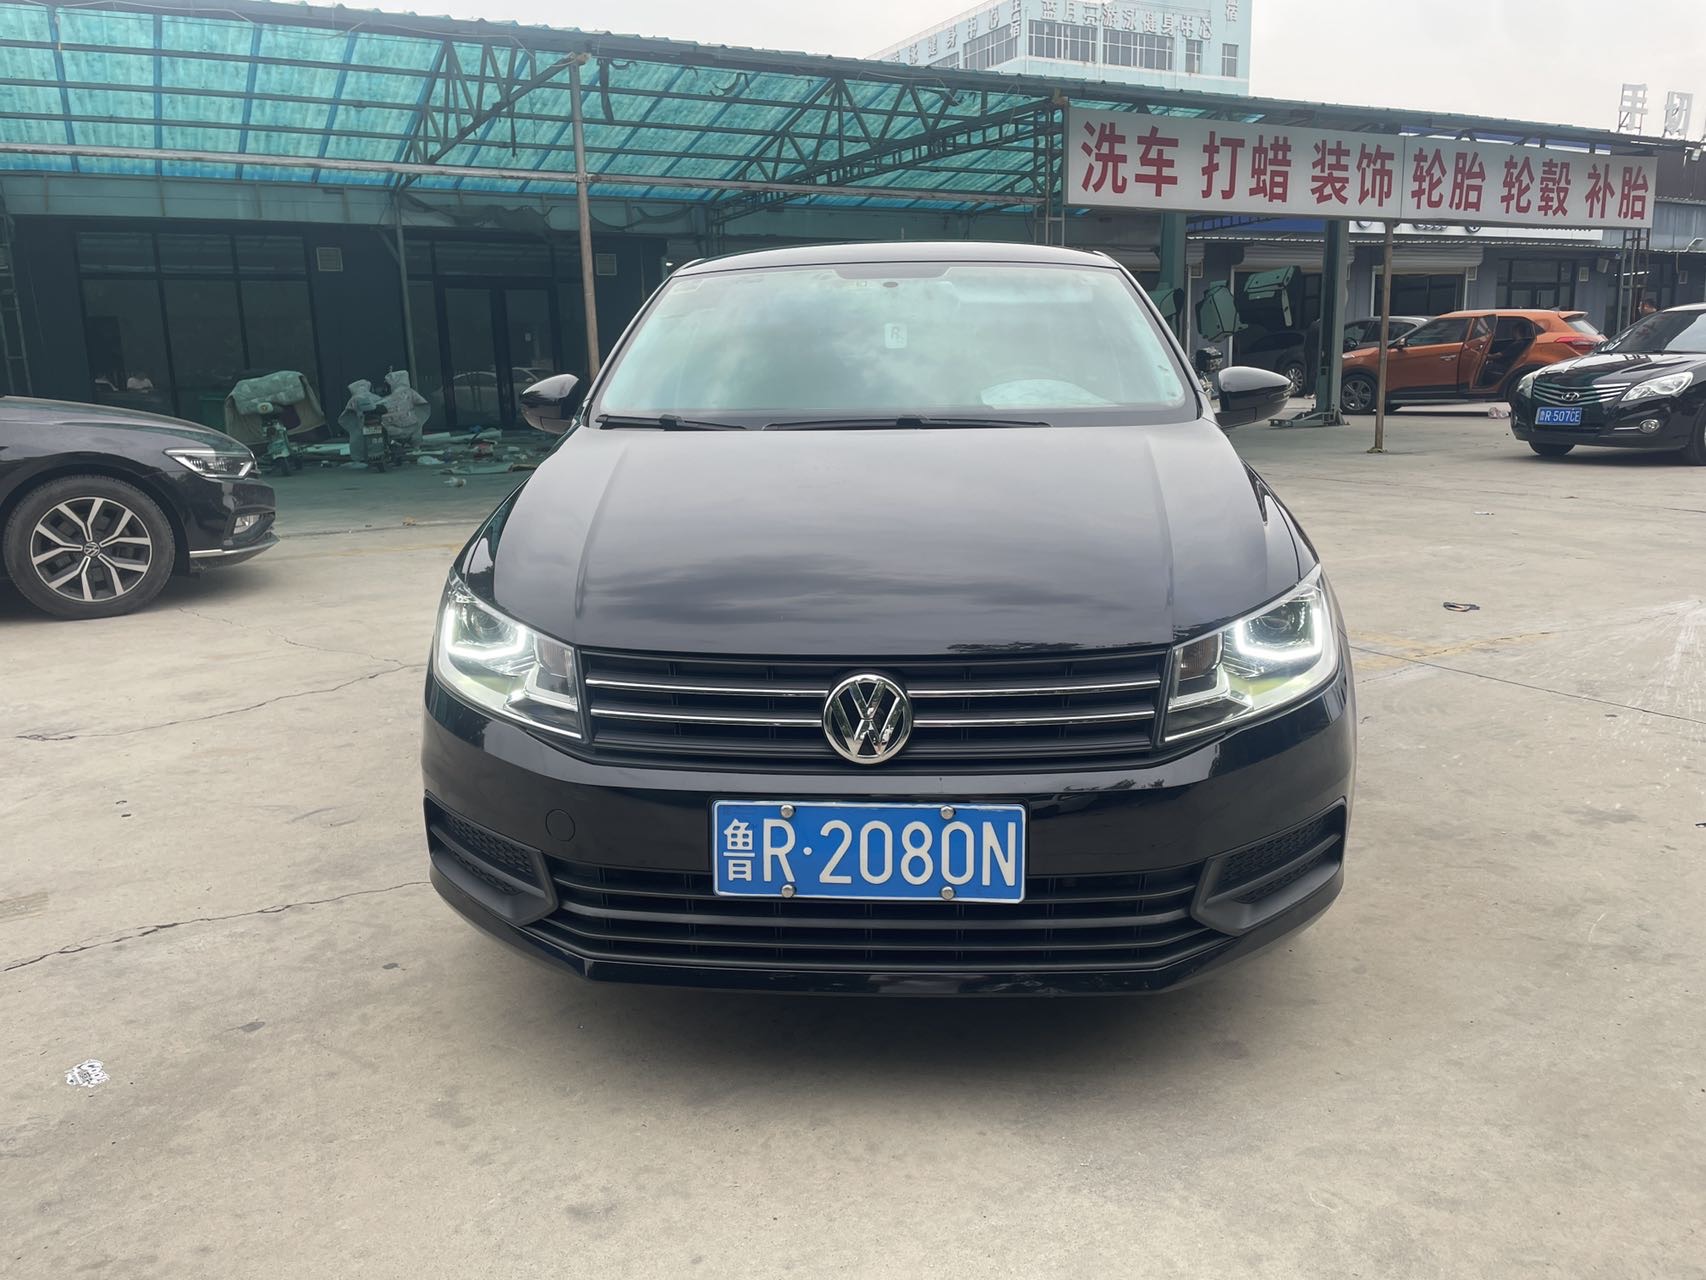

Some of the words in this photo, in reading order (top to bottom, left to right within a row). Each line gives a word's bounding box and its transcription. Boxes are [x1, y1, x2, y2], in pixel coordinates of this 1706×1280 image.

[1081, 121, 1178, 197] 洗车
[1201, 131, 1292, 203] 打蜡
[1311, 139, 1395, 207] 装饰
[1411, 147, 1487, 212] 轮胎
[1500, 154, 1572, 217] 轮毂
[1585, 164, 1649, 220] 补胎
[722, 818, 1017, 887] 鲁R·2080N
